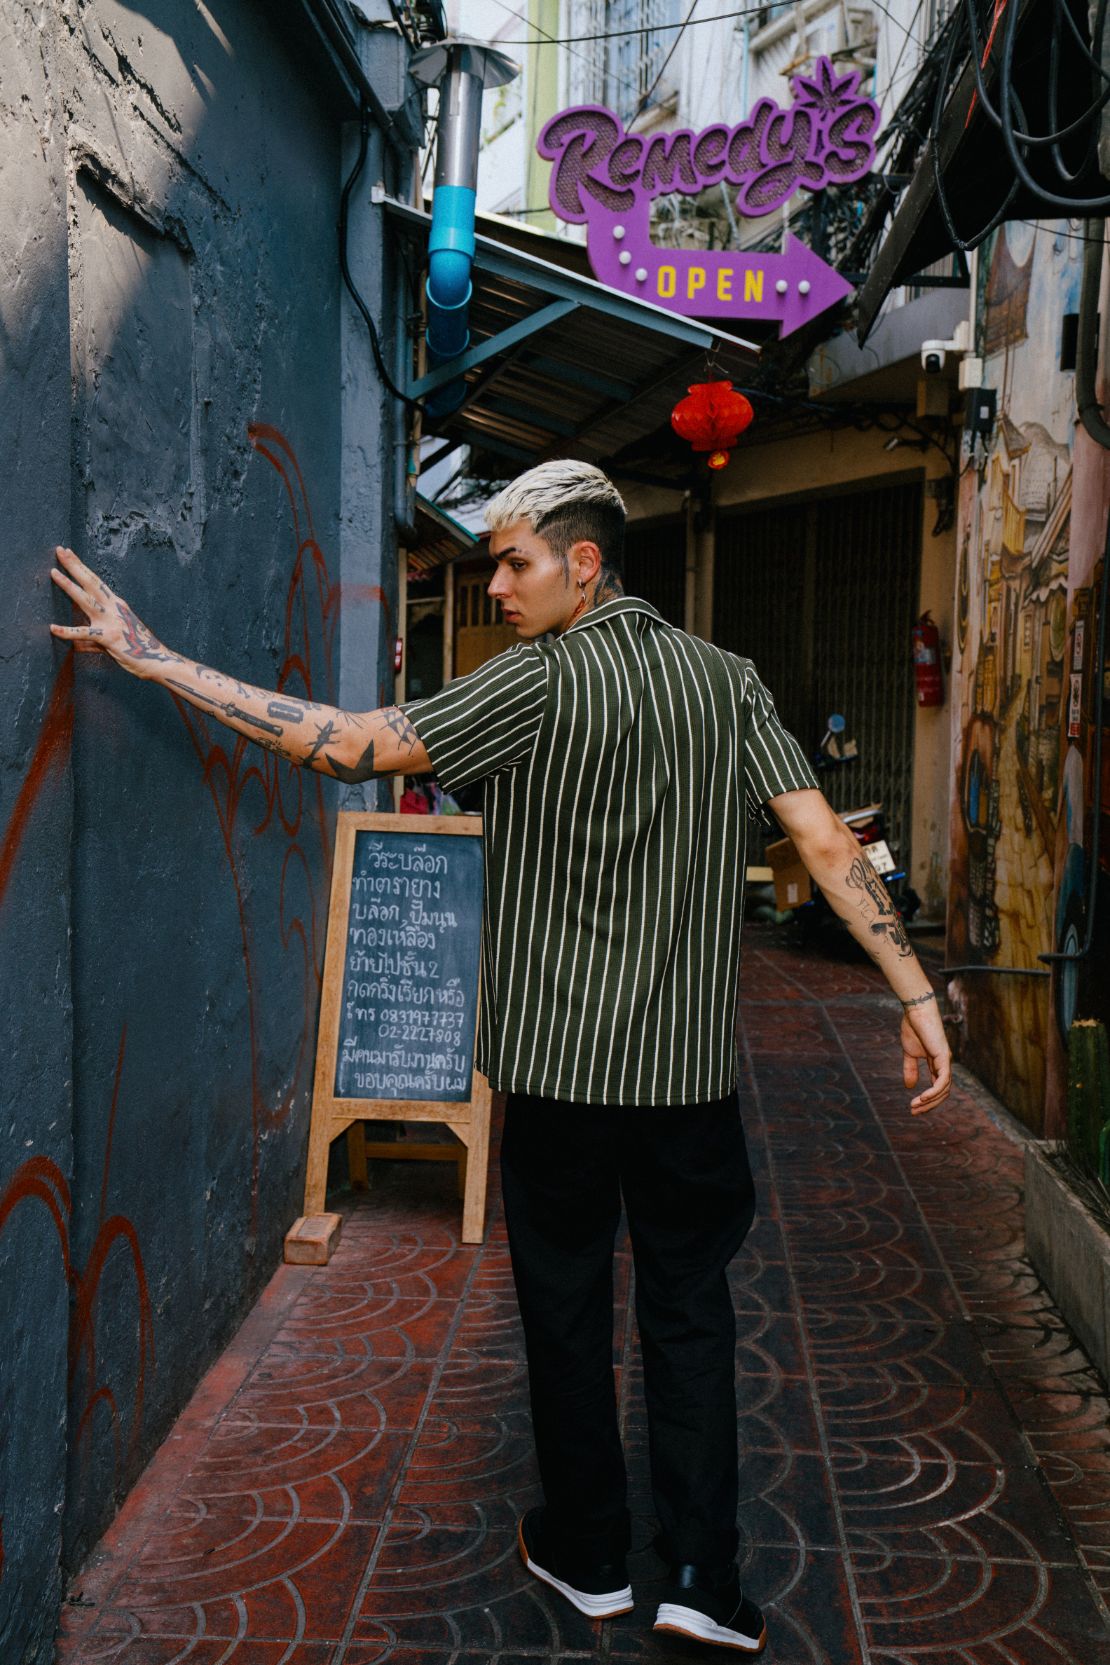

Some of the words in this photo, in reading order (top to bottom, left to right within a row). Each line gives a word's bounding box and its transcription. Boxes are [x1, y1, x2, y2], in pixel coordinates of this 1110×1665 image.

[657, 265, 764, 302] OPEN
[352, 870, 440, 898] ทำตรายาง
[346, 1001, 375, 1022] โทร
[378, 1024, 461, 1046] 02-2227808
